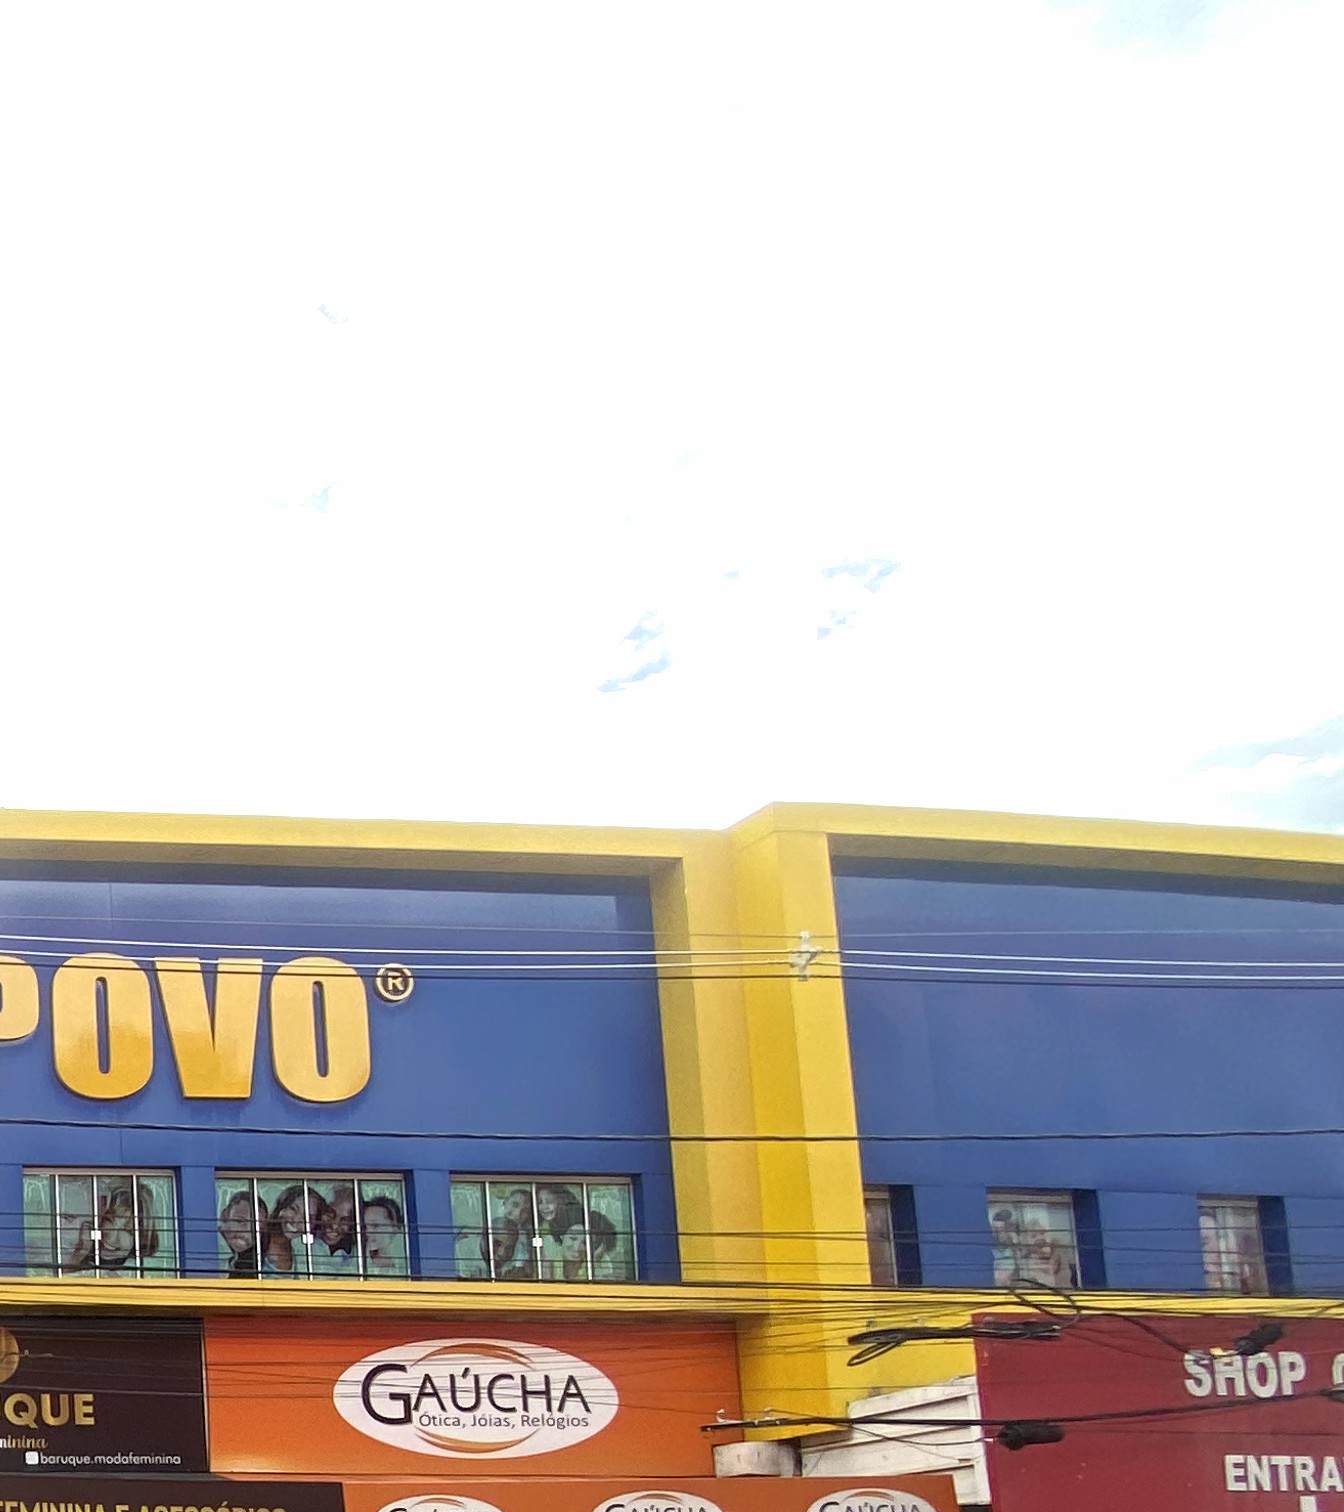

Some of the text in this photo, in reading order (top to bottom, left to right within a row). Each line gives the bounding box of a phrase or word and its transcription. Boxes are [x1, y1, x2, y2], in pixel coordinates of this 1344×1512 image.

[1183, 1351, 1306, 1398] SHOP
[361, 1364, 592, 1425] GAÚCHA
[418, 1413, 589, 1430] Ótica, Jóias, Relógios
[40, 1451, 181, 1467] baruque.modafeminina
[1224, 1455, 1344, 1492] ENTRA
